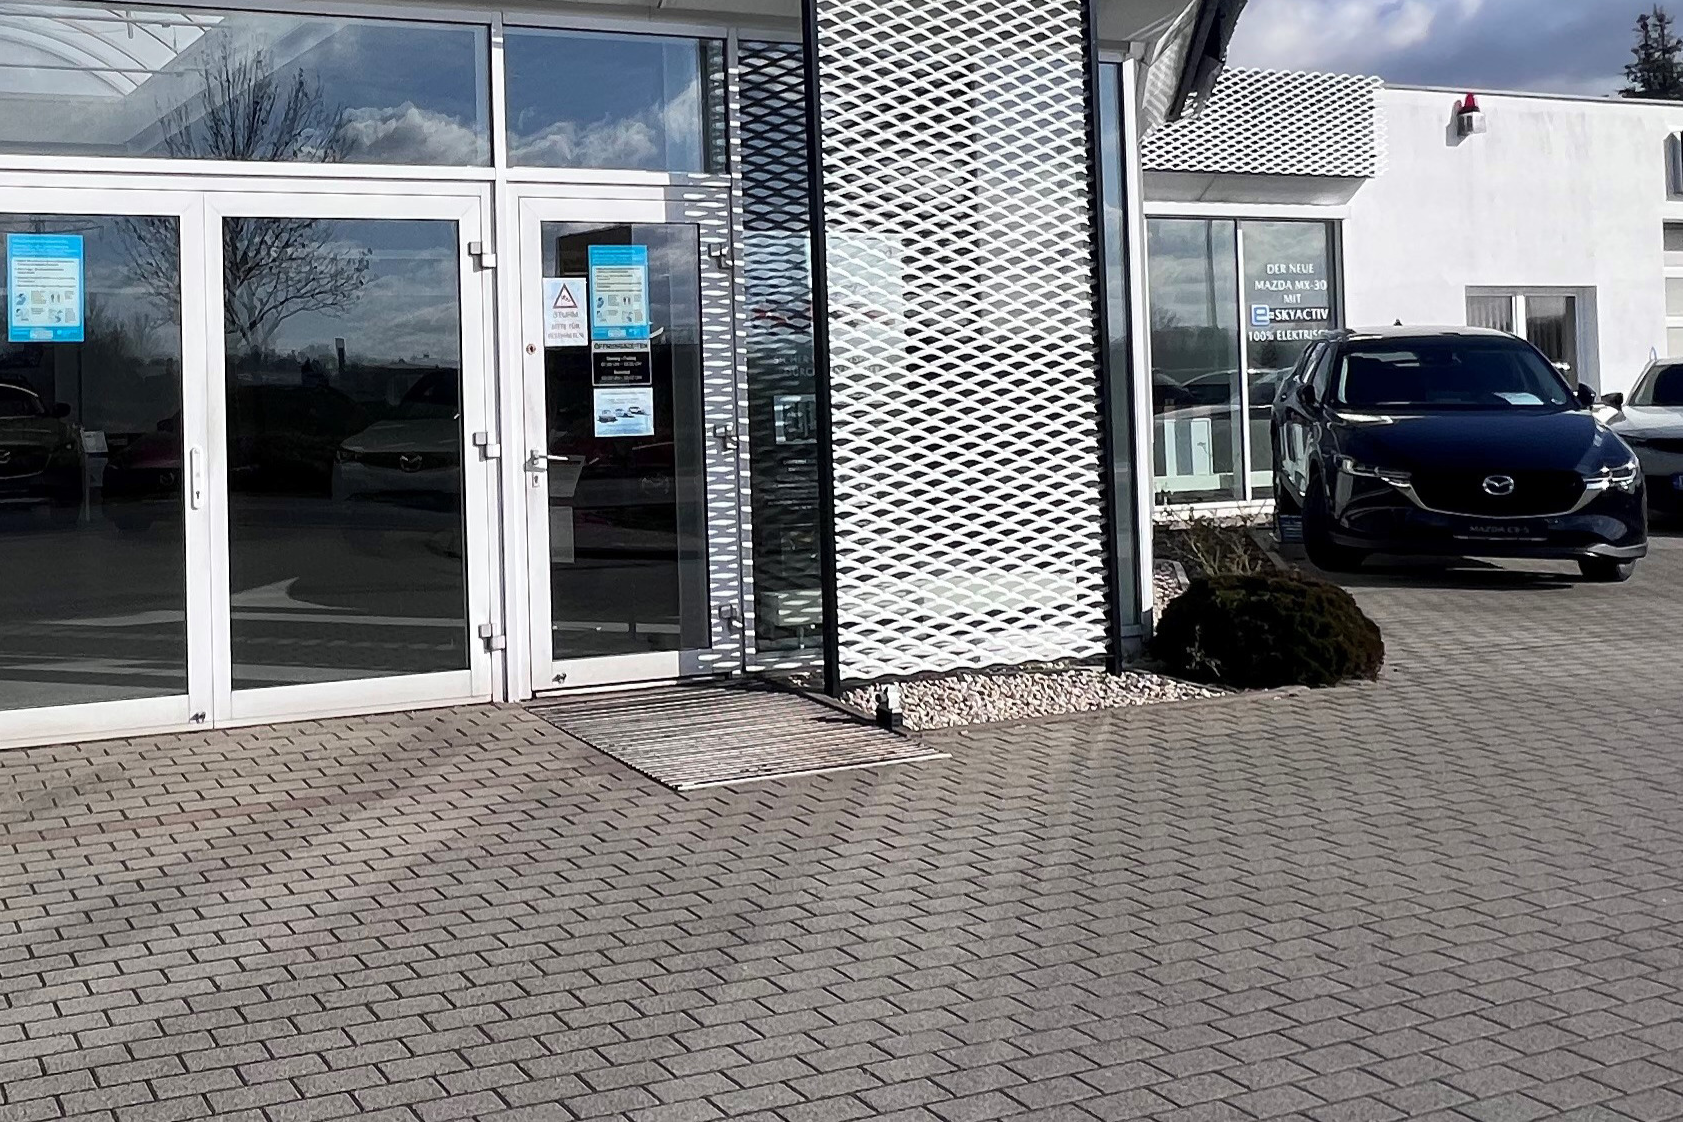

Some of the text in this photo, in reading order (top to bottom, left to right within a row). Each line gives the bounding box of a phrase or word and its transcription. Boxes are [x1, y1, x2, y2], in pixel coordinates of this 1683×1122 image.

[1266, 263, 1315, 275] DER NEUE
[1254, 280, 1327, 291] MAZDA MX-30
[1283, 293, 1302, 304] MIT
